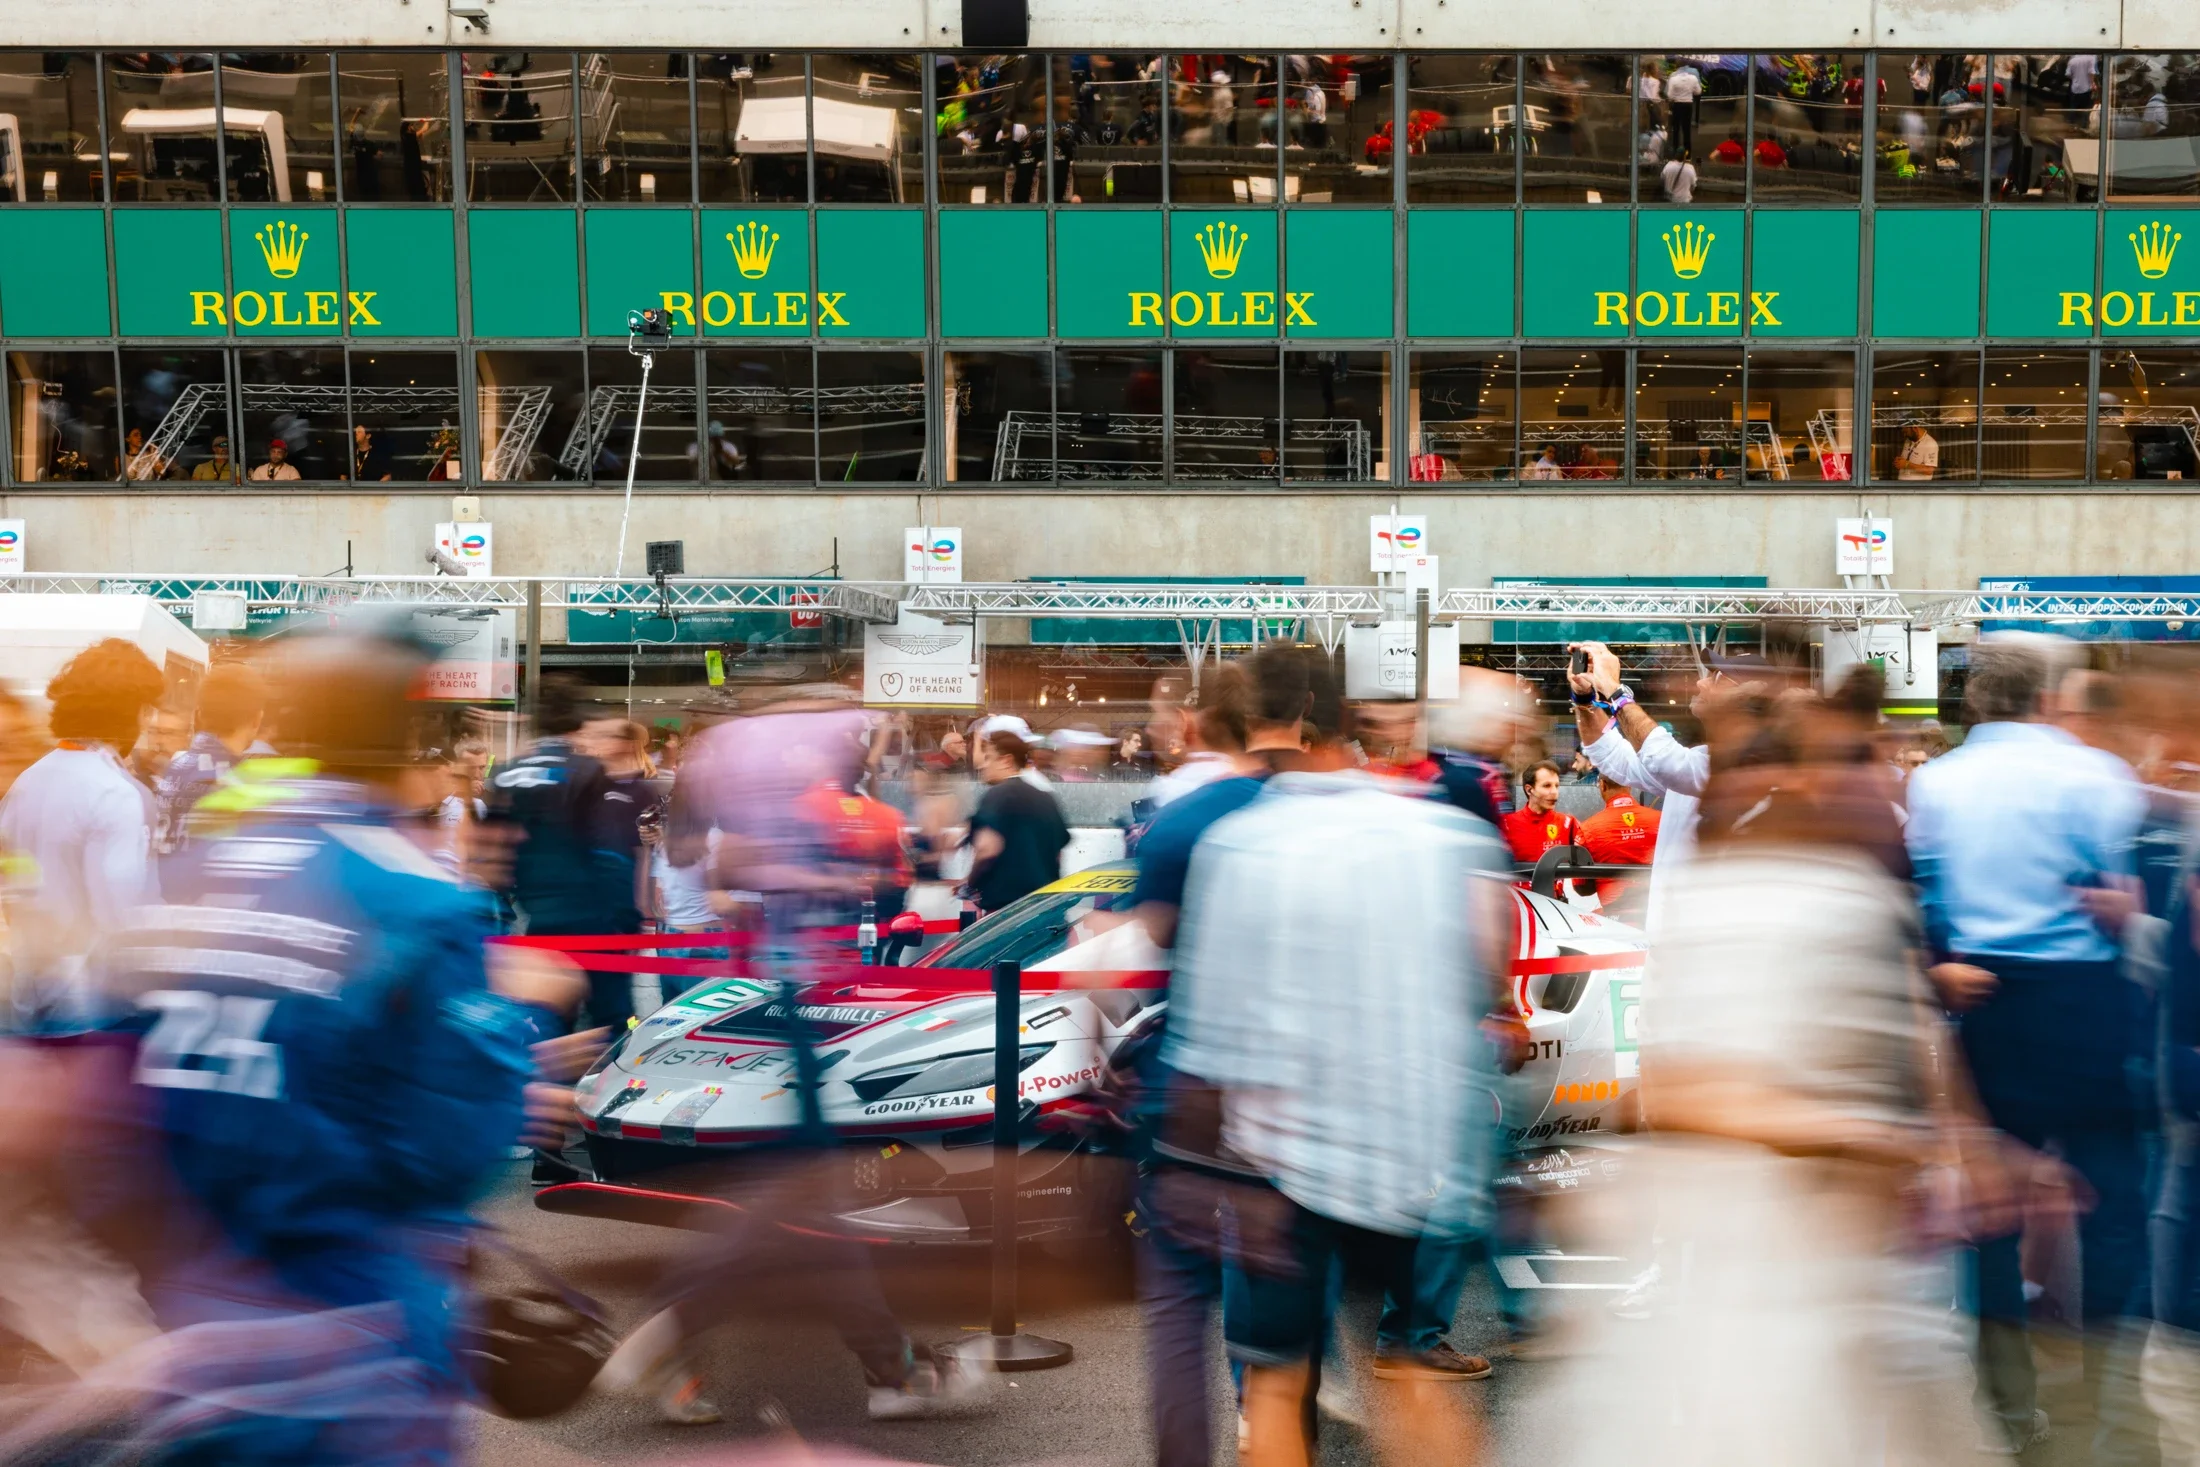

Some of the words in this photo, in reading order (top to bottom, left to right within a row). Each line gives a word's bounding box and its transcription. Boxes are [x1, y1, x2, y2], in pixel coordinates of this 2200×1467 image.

[190, 290, 382, 327] ROLEX
[659, 290, 850, 327] ROLEX
[1129, 290, 1316, 327] ROLEX
[1594, 290, 1782, 327] ROLEX
[2058, 290, 2200, 327] ROLE
[1843, 555, 1887, 564] TotalEnrgies
[912, 565, 956, 574] TotaEnergies
[167, 605, 195, 615] ASTO
[445, 672, 479, 680] HEART
[439, 680, 478, 689] RACING
[909, 685, 922, 693] OF
[925, 685, 962, 694] RACING
[828, 1008, 887, 1023] MILLE
[1553, 1079, 1621, 1106] PONOS
